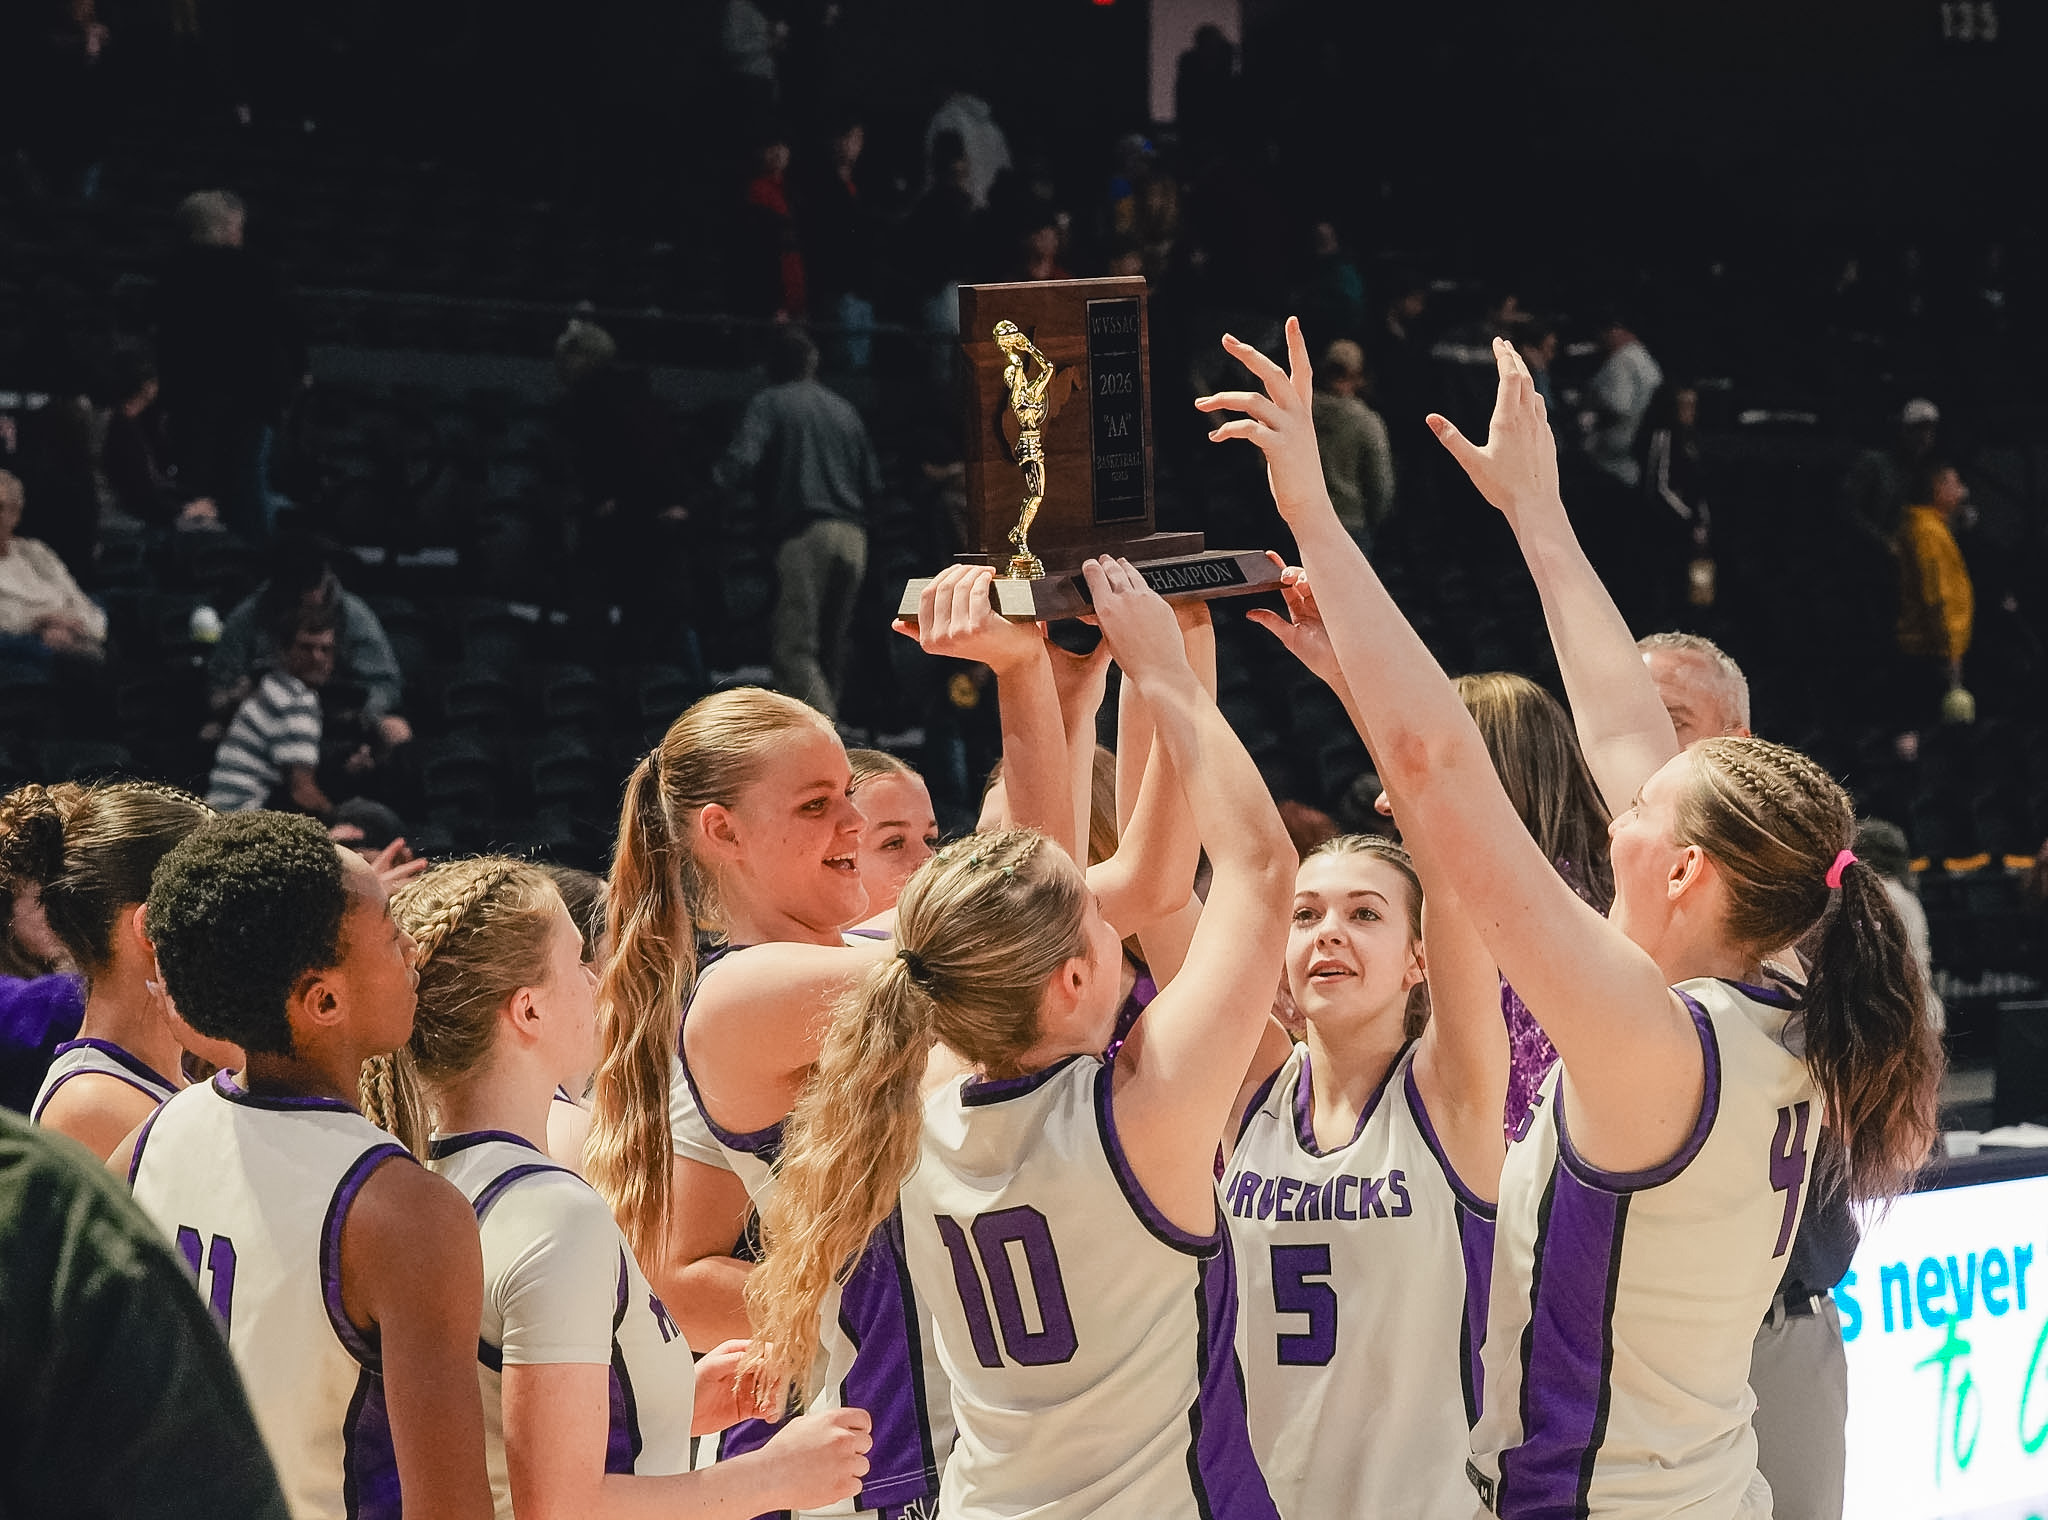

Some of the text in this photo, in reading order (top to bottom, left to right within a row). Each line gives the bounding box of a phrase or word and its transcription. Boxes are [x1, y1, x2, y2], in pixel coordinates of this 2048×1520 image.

[1092, 313, 1138, 335] WVSSAC
[1100, 371, 1133, 396] 2026
[1769, 1100, 1809, 1259] 4
[934, 1204, 1079, 1368] 10
[1270, 1243, 1338, 1367] 5
[1880, 1243, 2033, 1333] never
